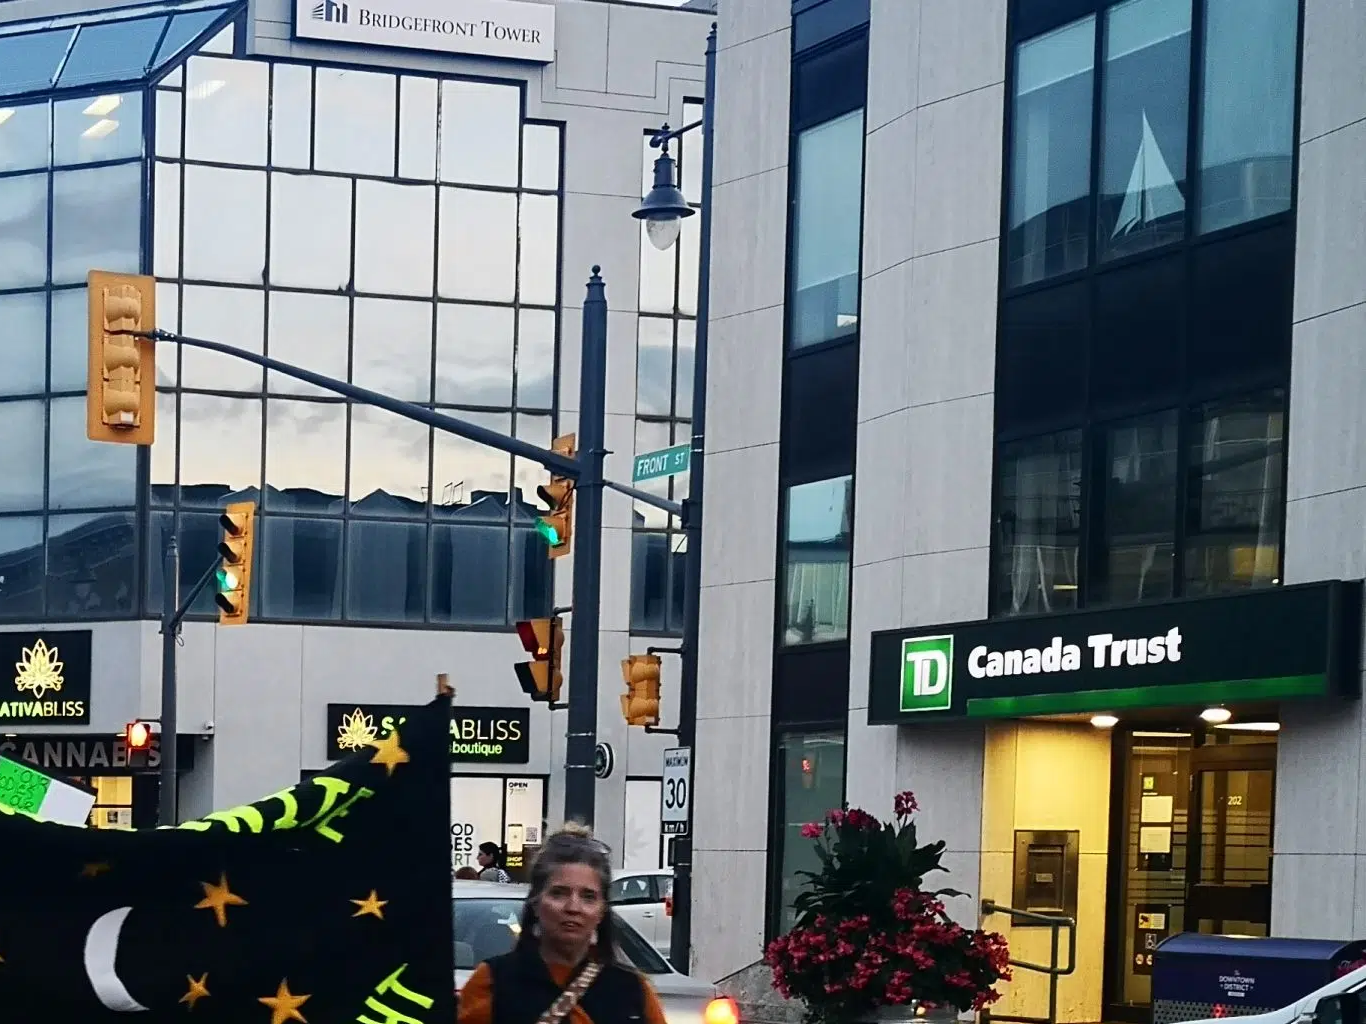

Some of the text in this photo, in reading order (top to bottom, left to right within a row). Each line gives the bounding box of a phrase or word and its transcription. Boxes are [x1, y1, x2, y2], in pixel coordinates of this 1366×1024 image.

[359, 9, 541, 44] BRIDGEFRONT TOWER
[637, 452, 685, 476] FRONT ST
[906, 626, 1182, 696] TD Canada Trust
[452, 741, 502, 755] boutique
[665, 778, 686, 809] 30
[1227, 796, 1243, 806] 202
[664, 822, 684, 833] km/h
[1219, 975, 1255, 984] DOWNTOWN
[1224, 983, 1249, 991] DISTRICT
